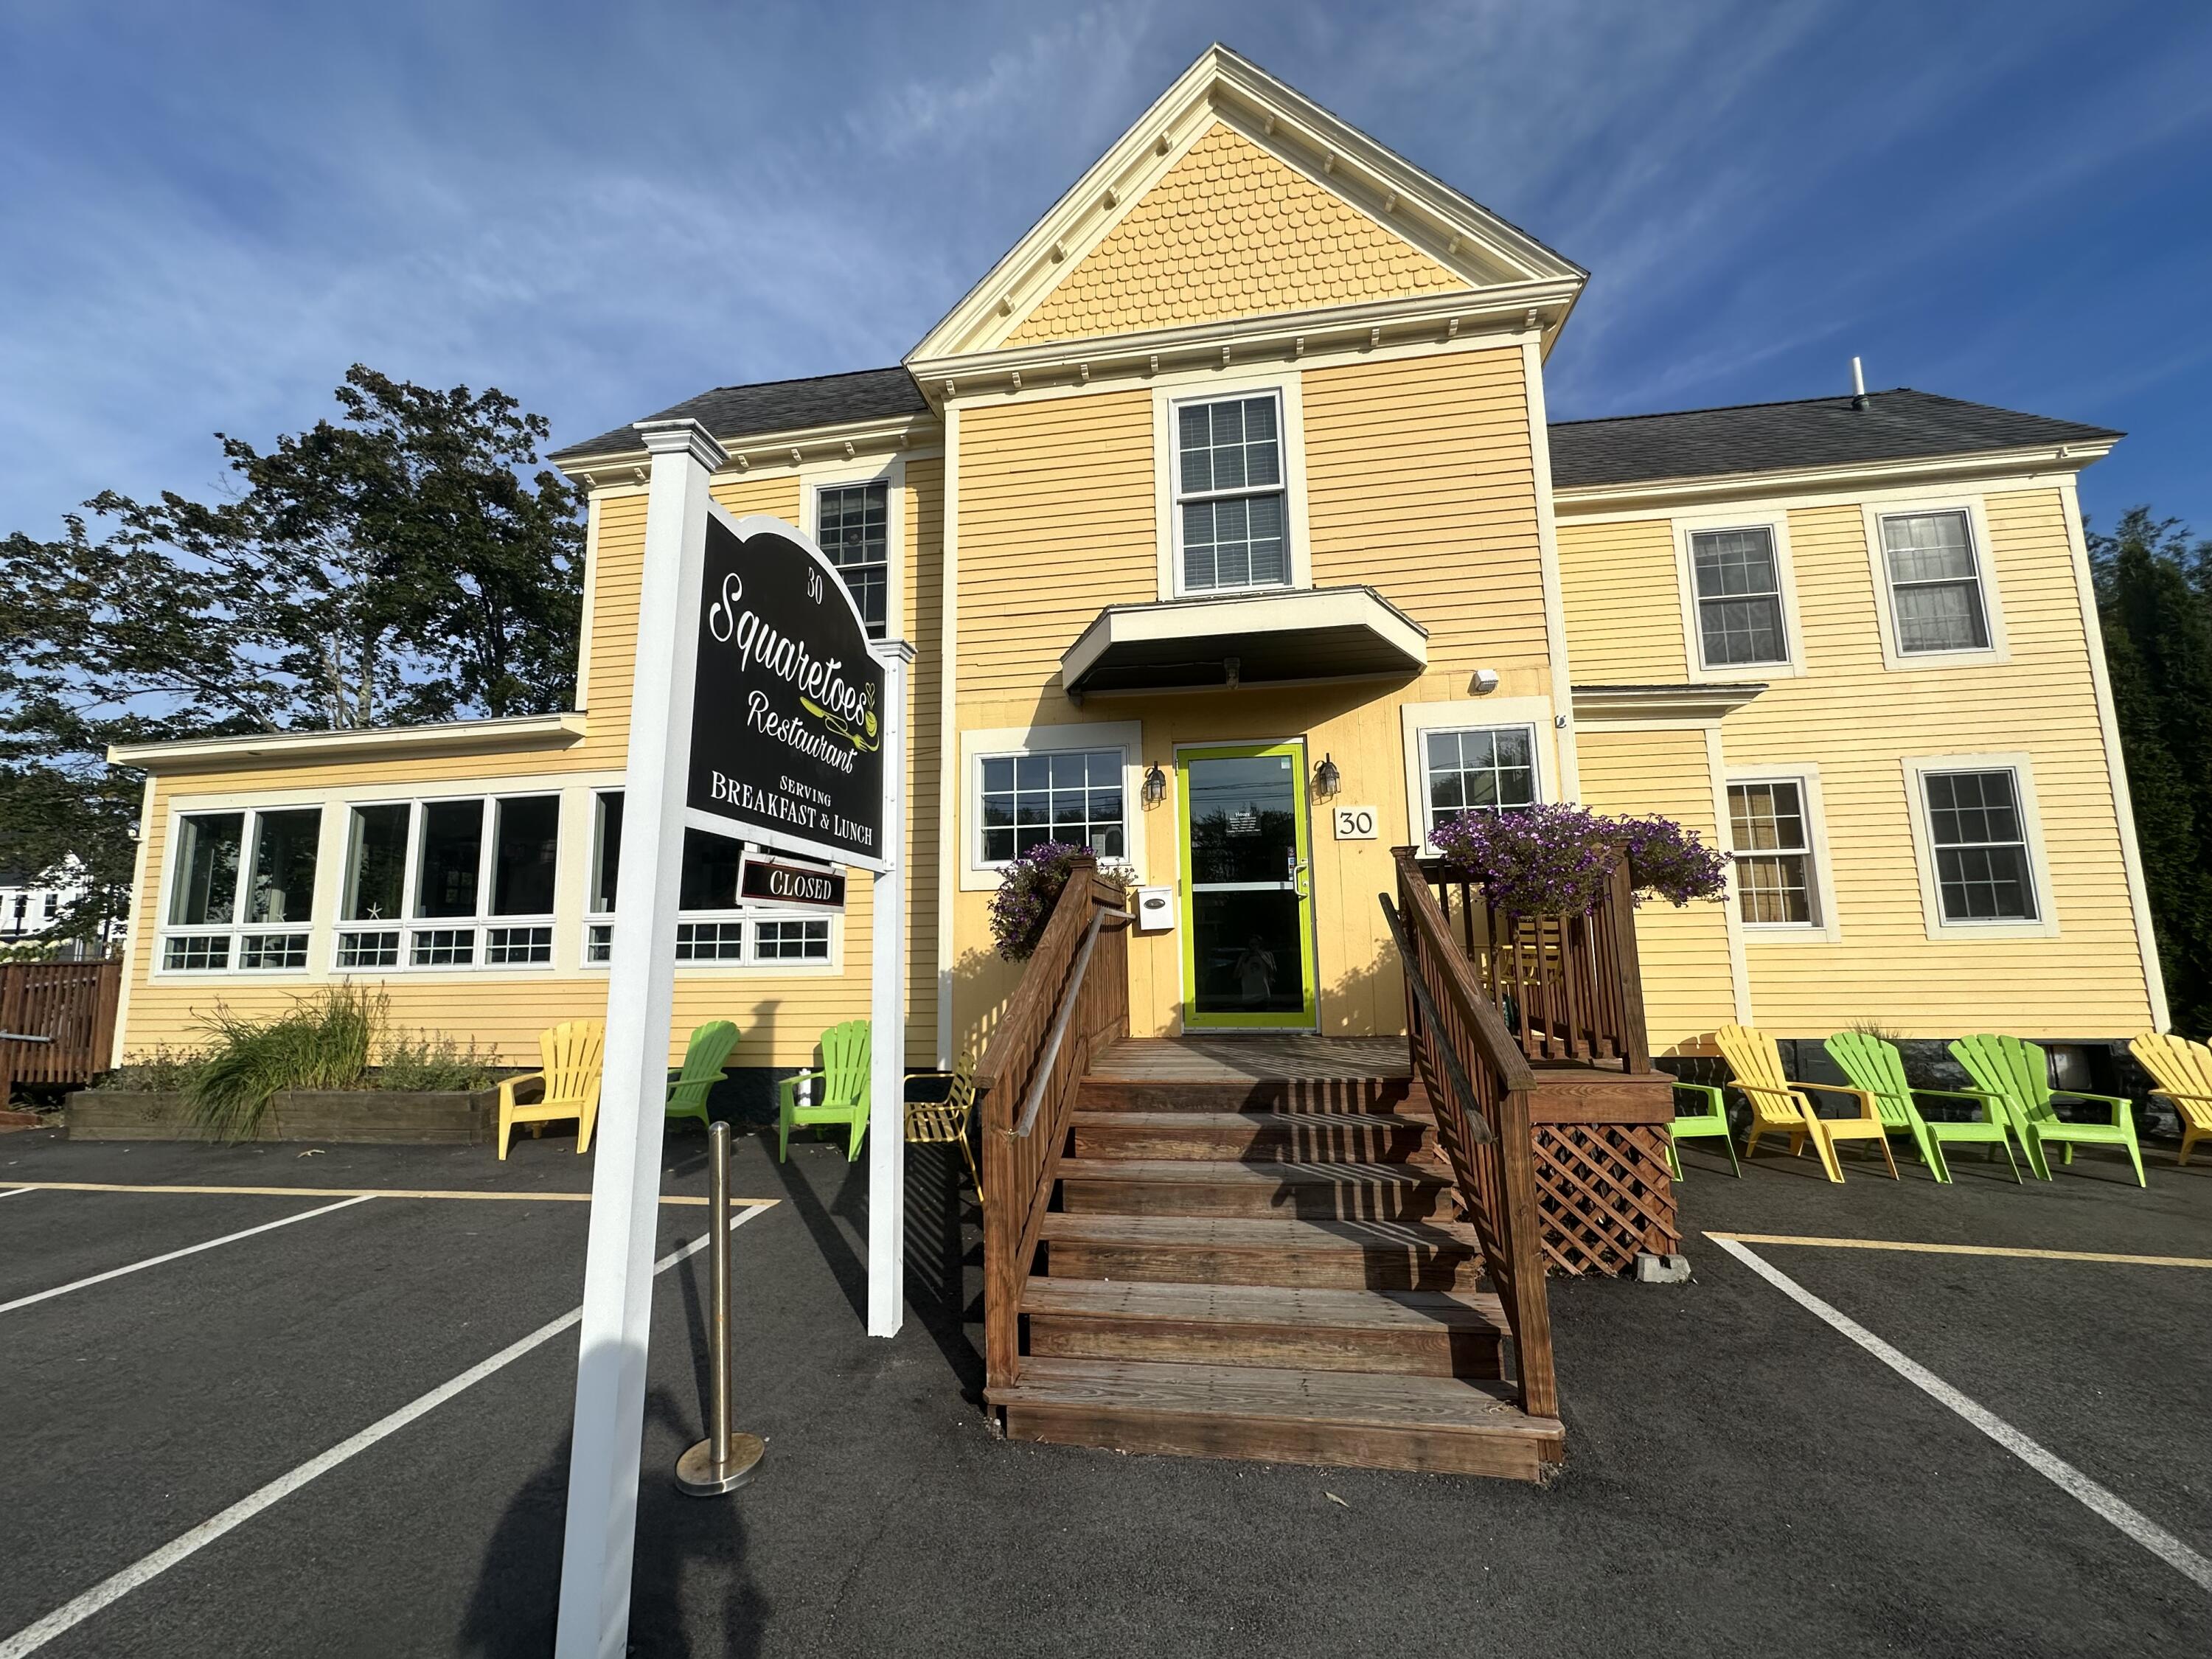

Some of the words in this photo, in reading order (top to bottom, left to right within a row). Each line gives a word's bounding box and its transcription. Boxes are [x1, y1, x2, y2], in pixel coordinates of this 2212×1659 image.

[807, 566, 823, 605] 30
[709, 572, 867, 726] Squaretoes
[747, 690, 858, 774] Restaurant
[710, 770, 817, 829] BREAKFAST
[820, 813, 830, 830] &
[834, 814, 873, 846] LUNCH
[779, 775, 832, 807] SERVING
[1340, 812, 1372, 834] 30
[770, 870, 832, 900] CLOSED
